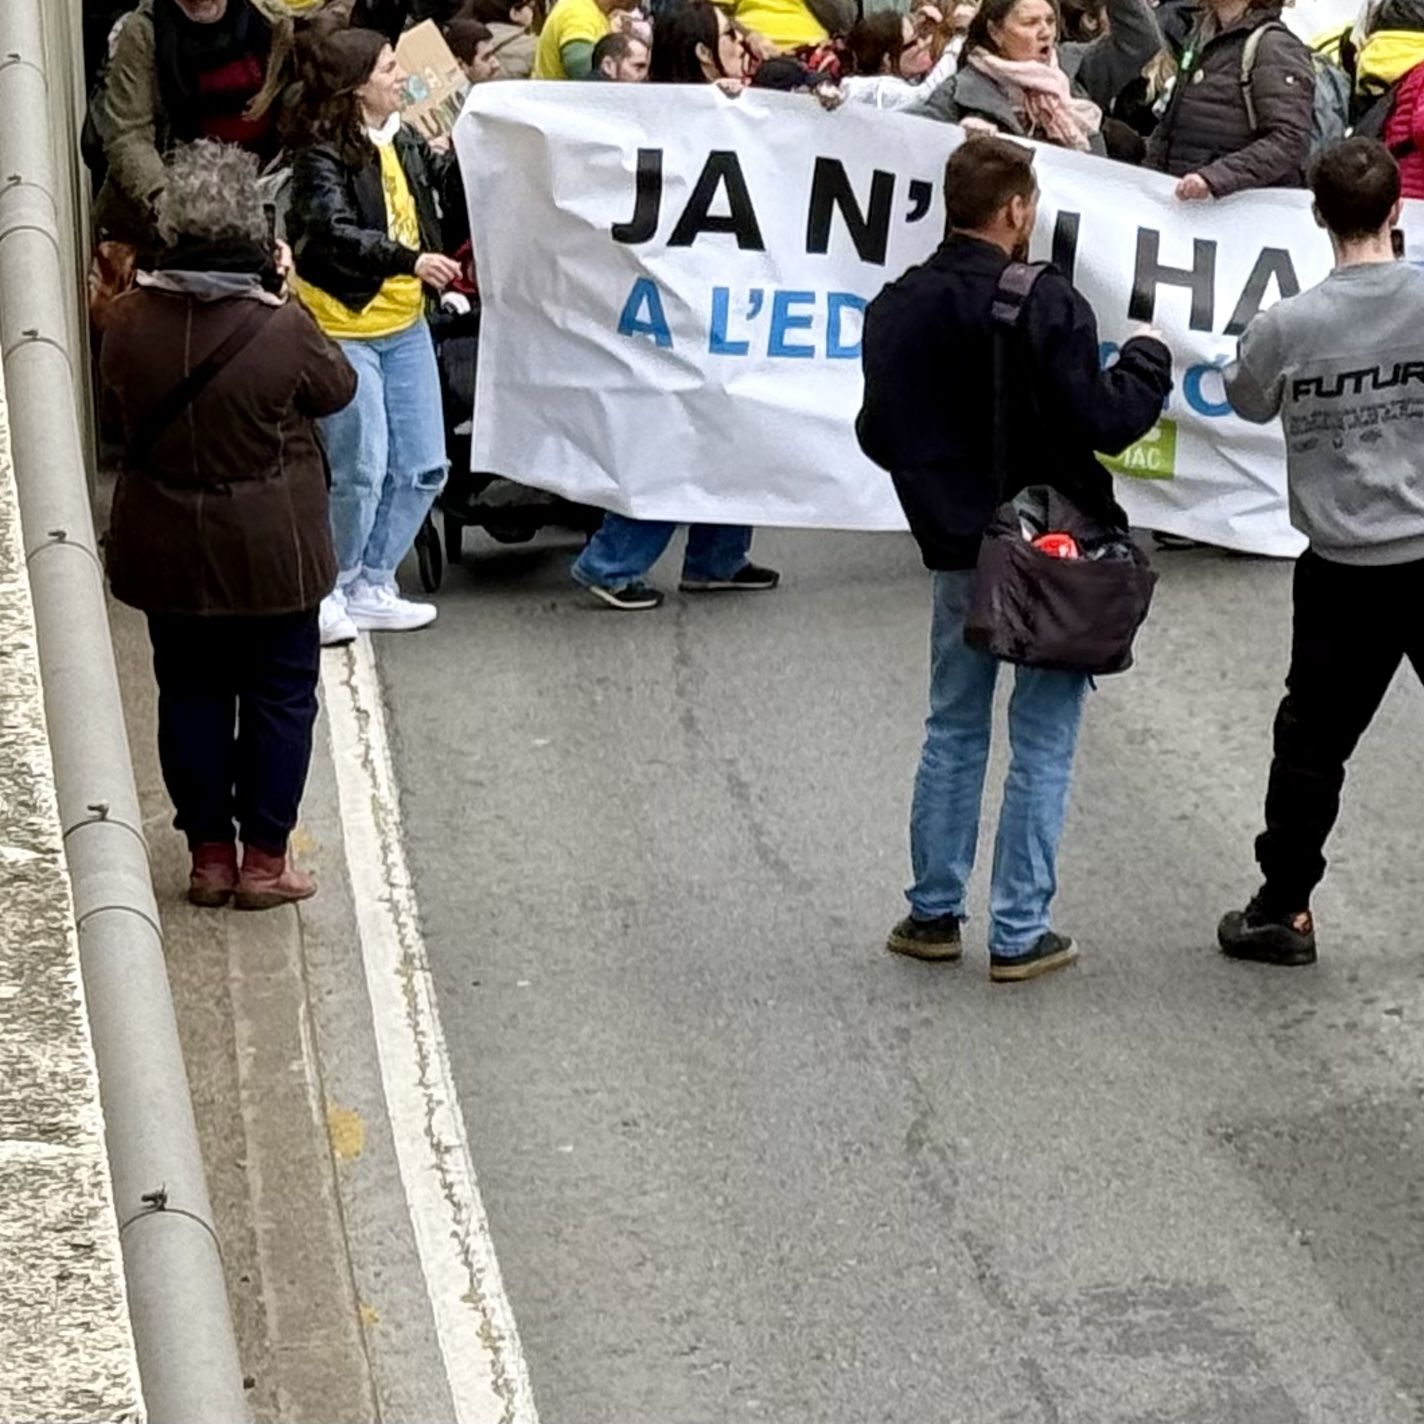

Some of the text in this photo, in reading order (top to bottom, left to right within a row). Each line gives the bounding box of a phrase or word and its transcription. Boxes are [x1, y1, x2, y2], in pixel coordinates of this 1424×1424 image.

[611, 148, 766, 252] JA
[1127, 225, 1301, 336] HA
[617, 276, 674, 350] A
